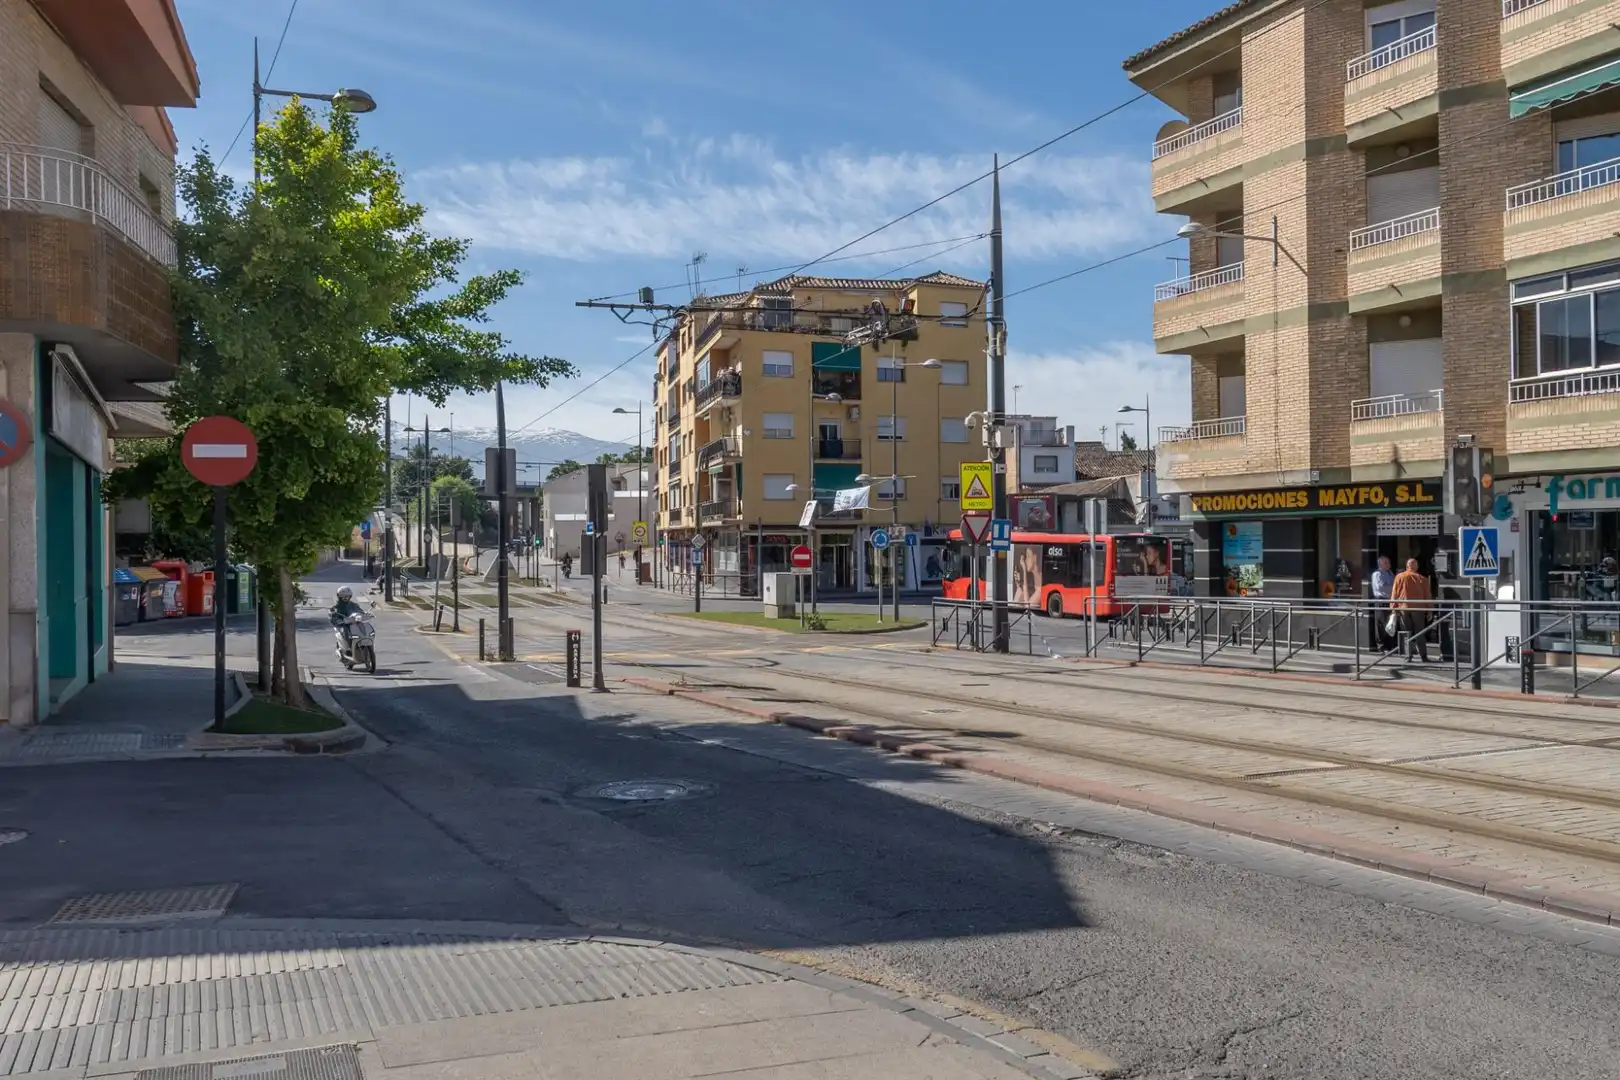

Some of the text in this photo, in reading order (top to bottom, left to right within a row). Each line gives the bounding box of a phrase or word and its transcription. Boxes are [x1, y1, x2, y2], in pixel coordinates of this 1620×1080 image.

[1192, 483, 1434, 512] PROMOCIONES MAYFO, S.L.
